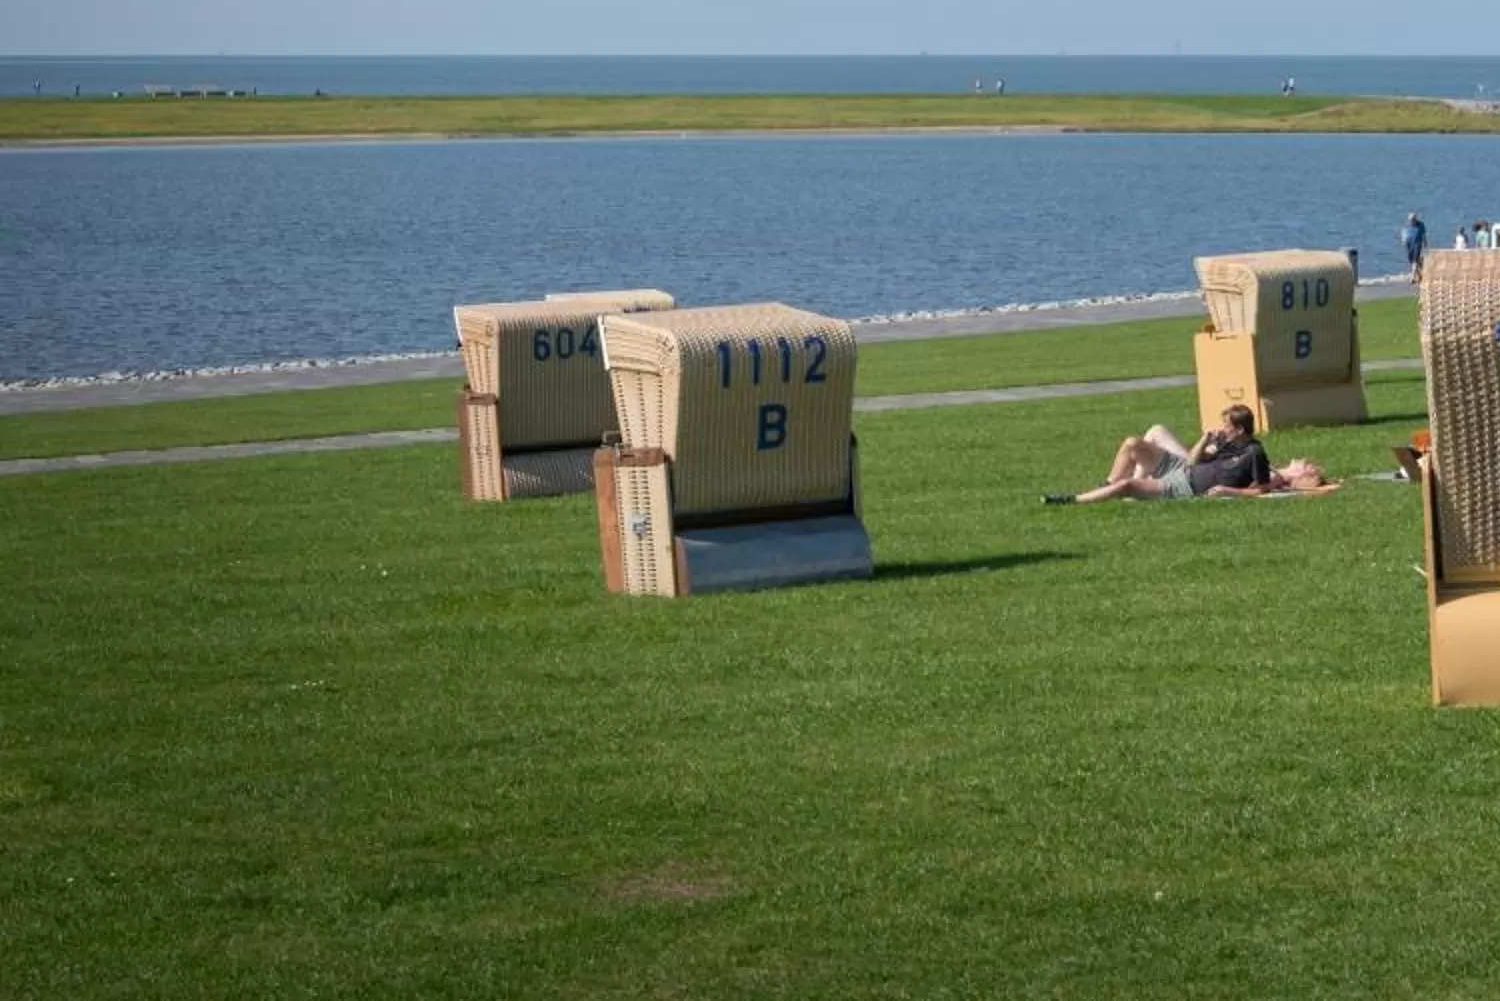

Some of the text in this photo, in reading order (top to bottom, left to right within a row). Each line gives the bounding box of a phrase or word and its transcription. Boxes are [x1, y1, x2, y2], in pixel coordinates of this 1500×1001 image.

[1281, 278, 1329, 312] 810
[534, 325, 598, 361] 604
[1295, 330, 1313, 360] B
[716, 334, 827, 389] 1112
[757, 403, 787, 451] B
